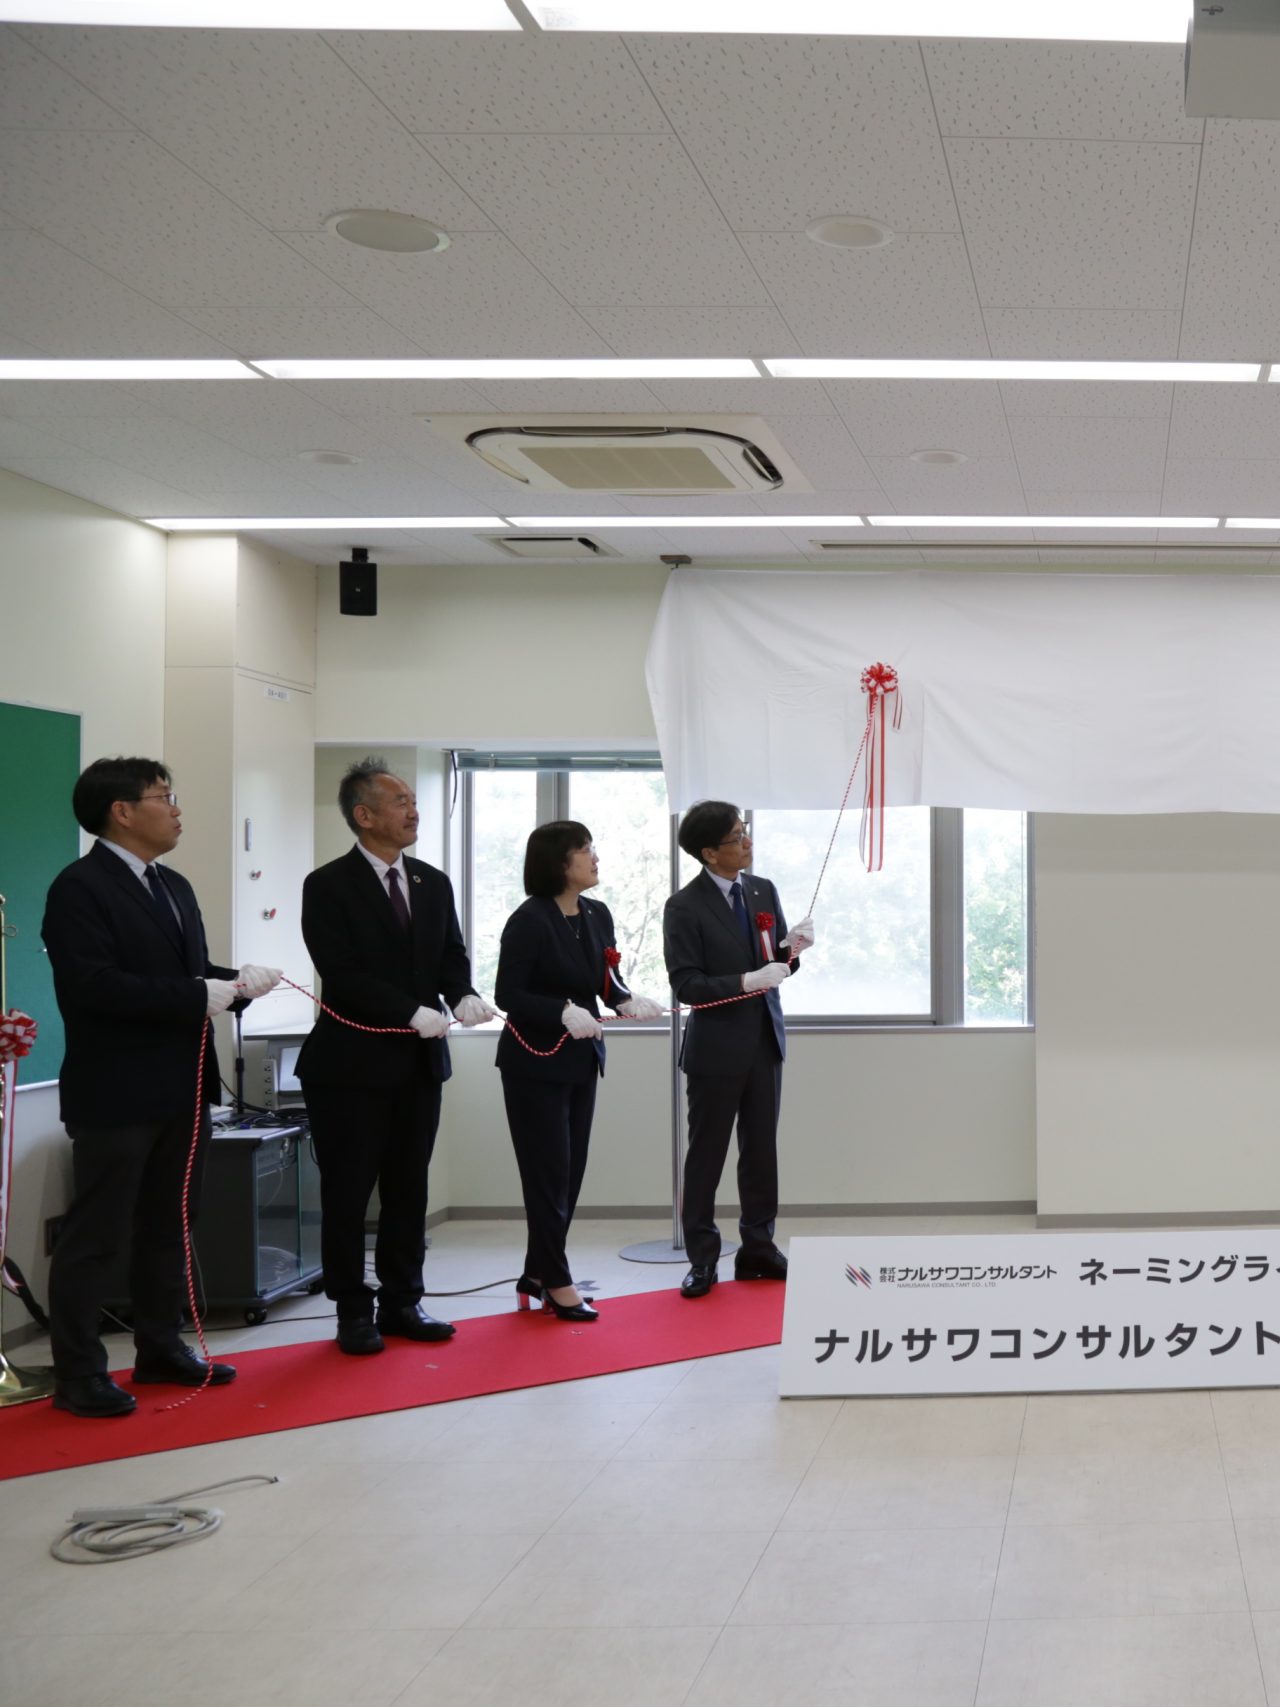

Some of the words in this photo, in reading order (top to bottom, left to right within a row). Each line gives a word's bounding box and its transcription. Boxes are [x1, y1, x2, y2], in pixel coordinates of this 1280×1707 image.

[898, 1265, 1058, 1281] ナルサワコンサルタント
